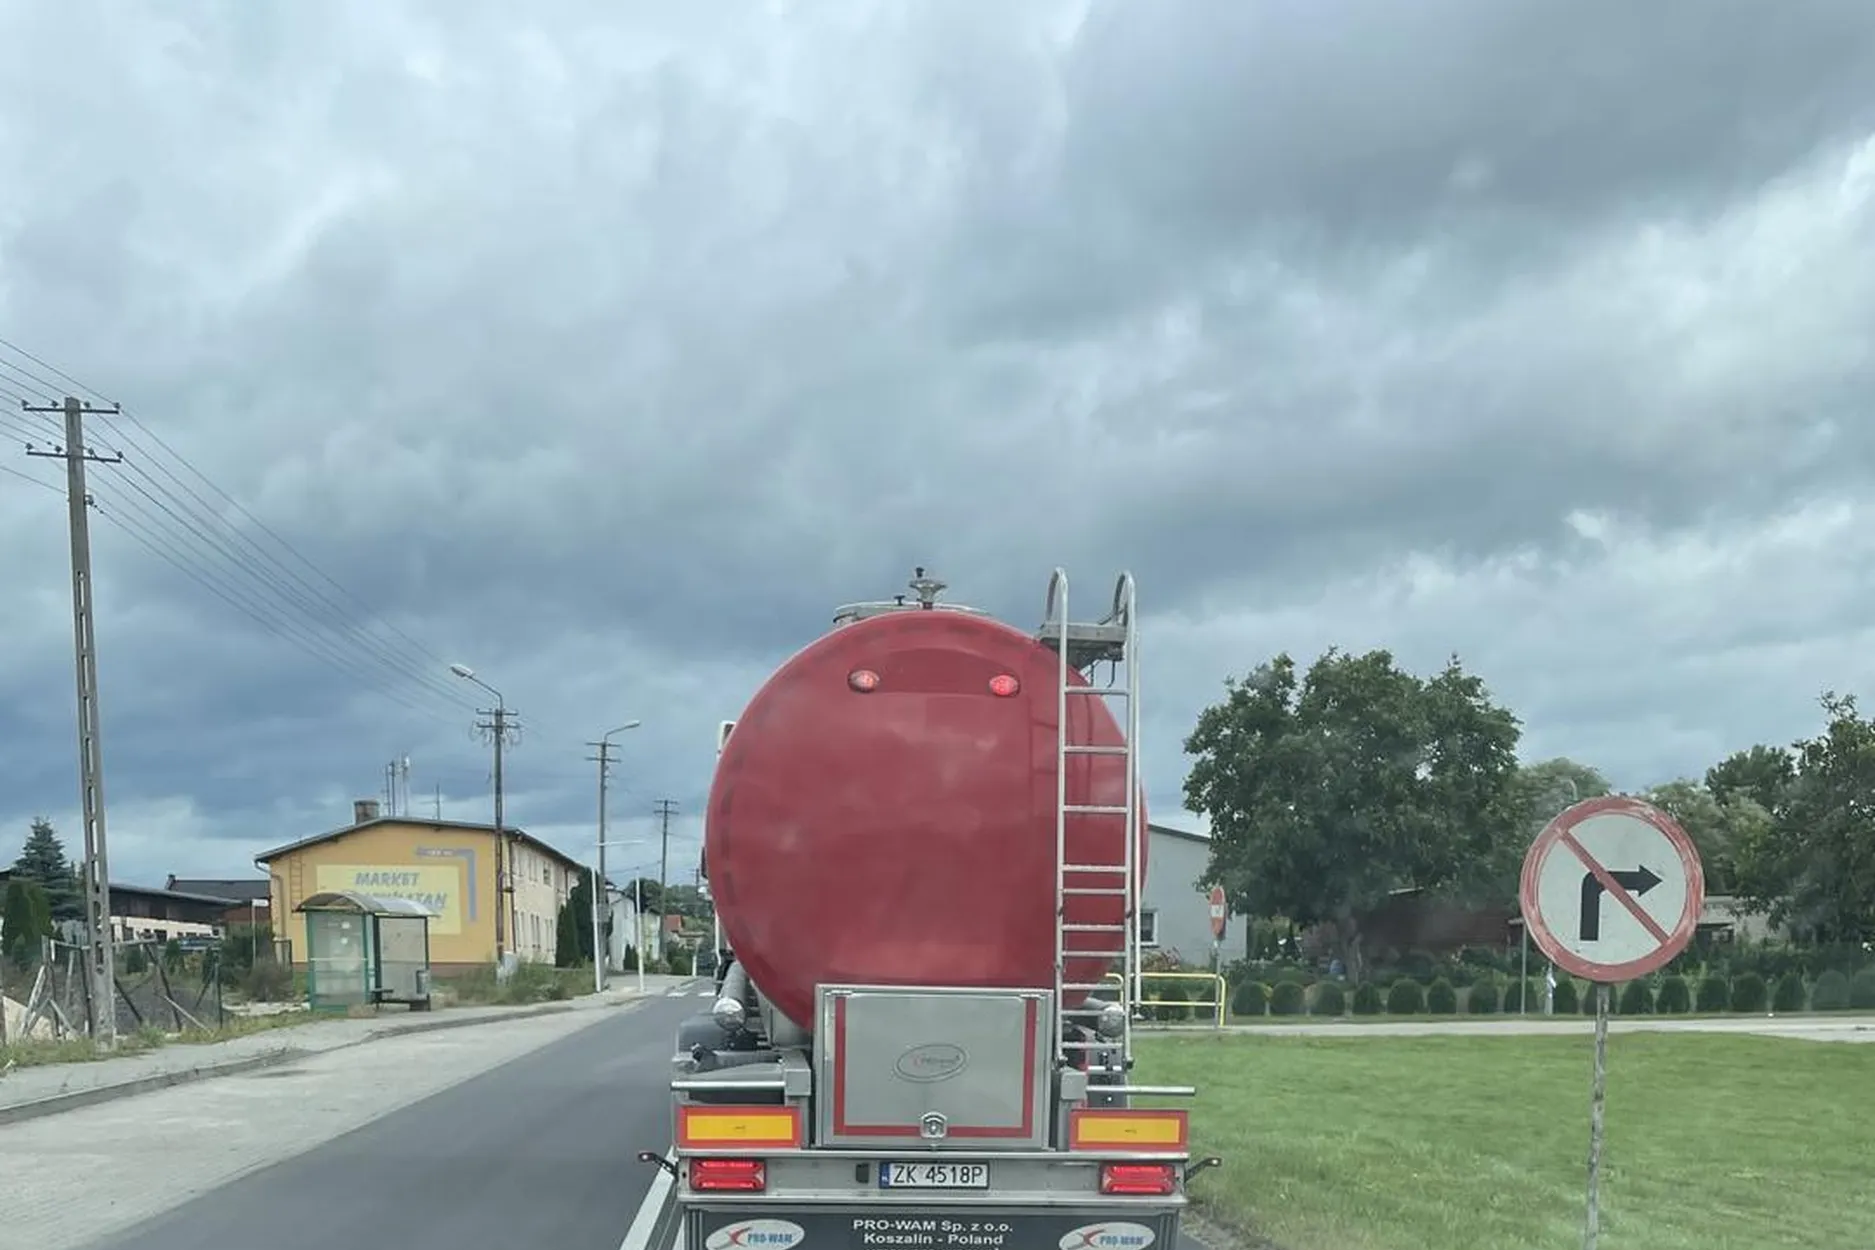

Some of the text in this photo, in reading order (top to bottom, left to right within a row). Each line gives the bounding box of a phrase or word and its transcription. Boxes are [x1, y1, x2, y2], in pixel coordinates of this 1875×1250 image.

[355, 872, 420, 887] MARKET
[893, 1165, 984, 1184] ZK 4518P
[853, 1219, 1013, 1233] PRO-WAM Sp. z o.o.
[864, 1233, 933, 1245] Koszalin
[948, 1234, 1004, 1245] Poland
